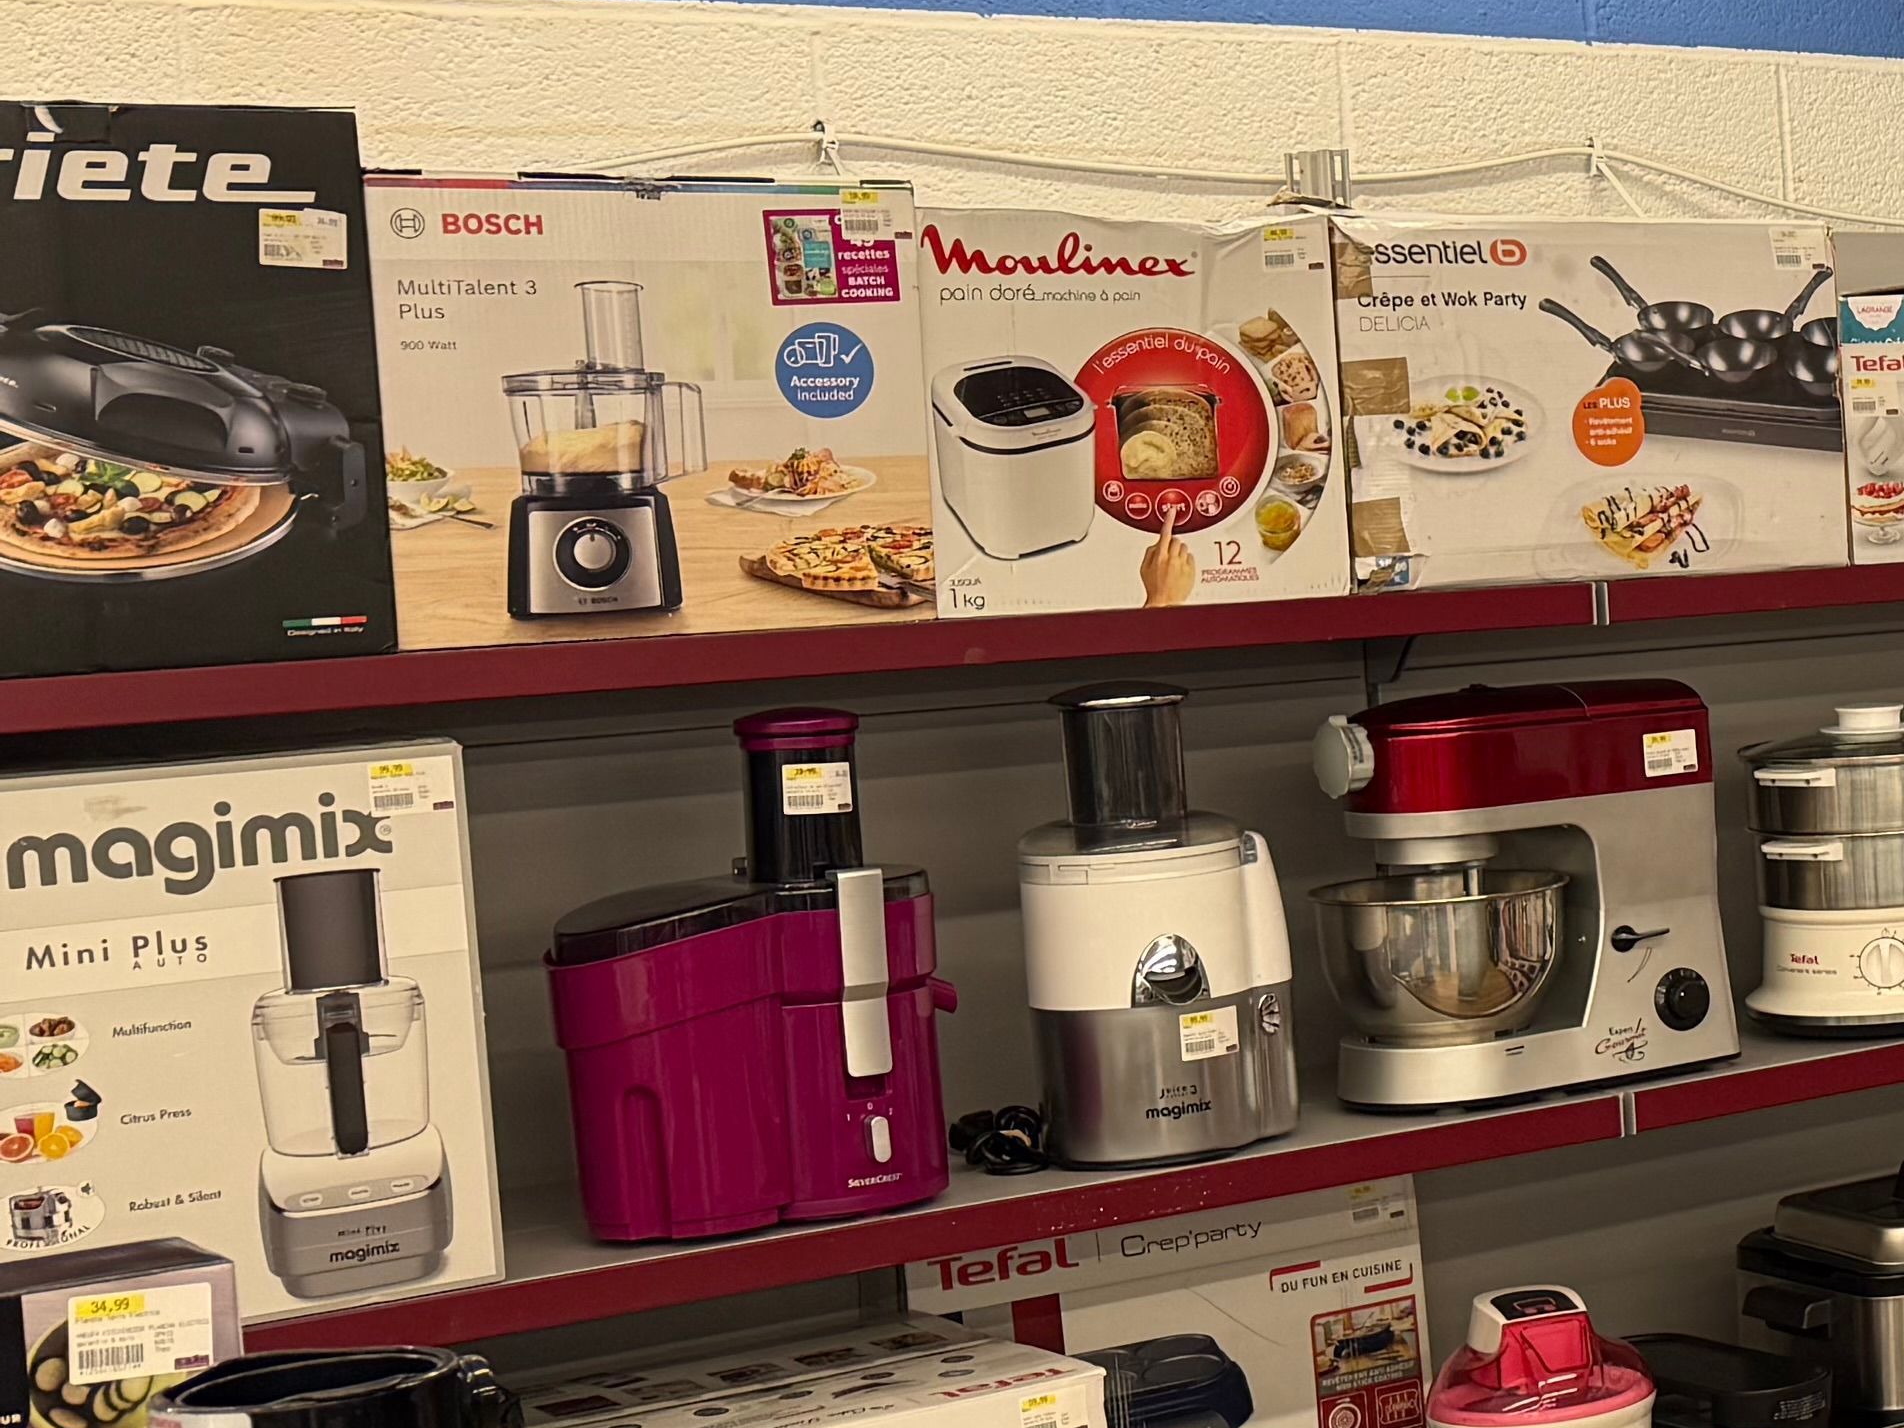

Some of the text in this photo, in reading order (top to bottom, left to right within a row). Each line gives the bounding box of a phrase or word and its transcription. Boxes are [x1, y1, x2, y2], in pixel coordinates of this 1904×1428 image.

[441, 212, 544, 236] BOSCH
[838, 250, 890, 260] recettes
[921, 222, 1194, 279] Moulinex
[397, 278, 538, 298] MultiTalent 3
[848, 276, 885, 285] BATCH
[841, 288, 893, 297] COOKING
[940, 283, 1036, 306] pain doré
[1356, 289, 1528, 313] Crêpe et Wok Party
[398, 303, 446, 321] Plus
[1359, 316, 1431, 332] DELICIA
[400, 339, 458, 351] 900 Watt
[790, 376, 859, 388] Accessory
[798, 389, 853, 400] included
[1599, 397, 1630, 408] PLUS
[1214, 540, 1243, 566] 12
[948, 588, 985, 612] 1 kg
[6, 792, 393, 894] magimix
[26, 931, 209, 970] Mini Plus
[132, 953, 208, 968] AUTO
[112, 1020, 192, 1039] Multifunction
[120, 1107, 192, 1127] Citrus Press
[1145, 1100, 1212, 1121] magimix
[329, 1239, 400, 1264] magimix
[928, 1237, 1080, 1292] Tefal
[1281, 1260, 1402, 1293] DU FUN EN CUISINE
[90, 1298, 130, 1314] 34,99
